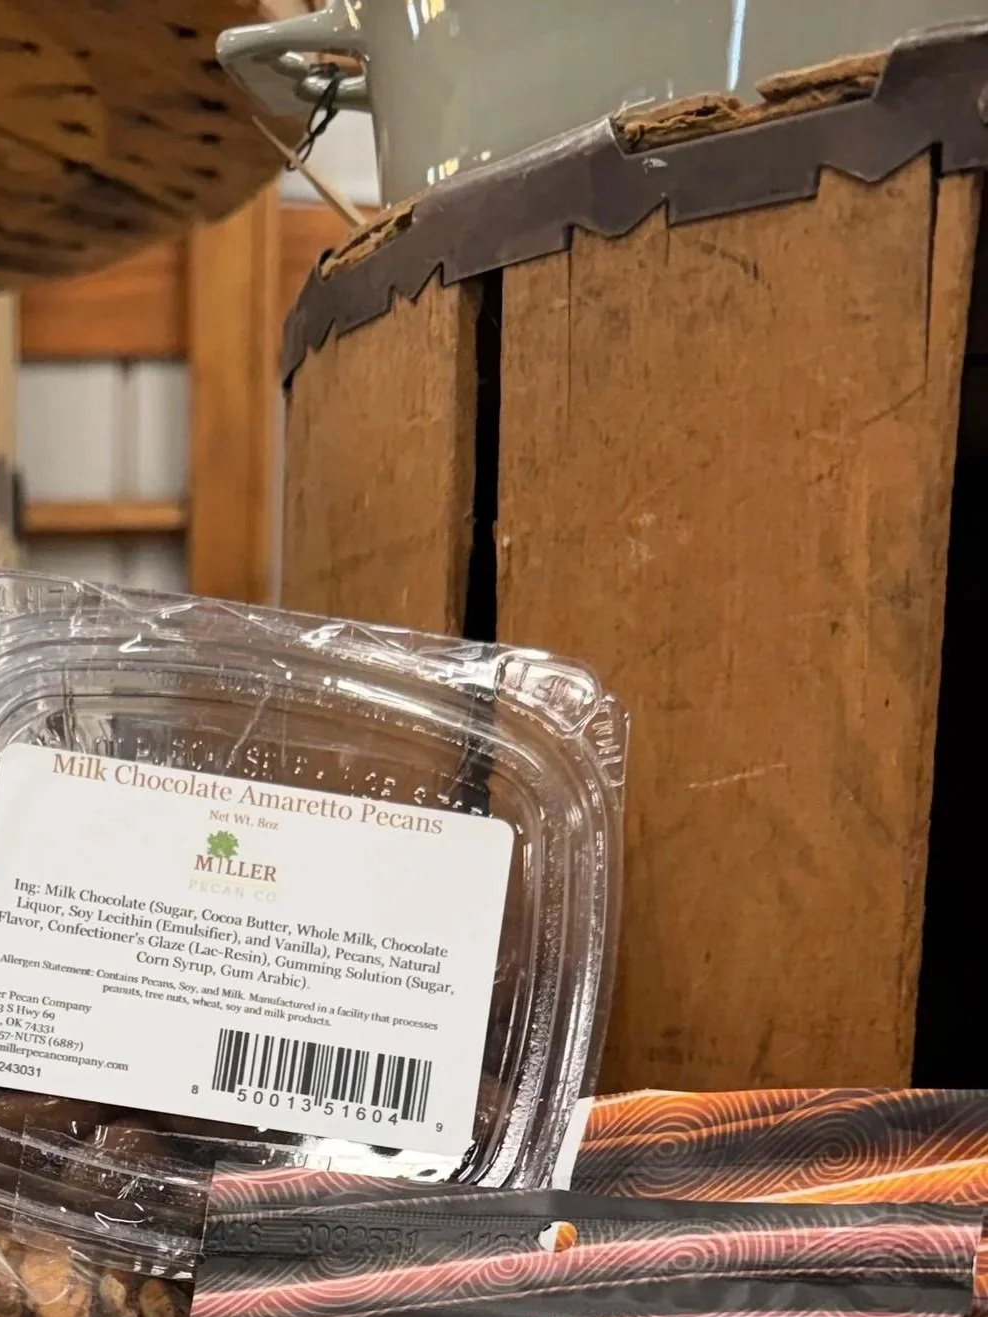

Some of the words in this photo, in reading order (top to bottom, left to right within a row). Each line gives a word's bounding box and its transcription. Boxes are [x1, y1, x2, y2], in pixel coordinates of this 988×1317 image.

[52, 753, 106, 781] Milk
[114, 764, 232, 801] Chocolate
[239, 785, 352, 820] Amaretto
[360, 803, 442, 834] Pecans
[209, 809, 230, 822] Net
[233, 813, 253, 826] Wt.
[257, 817, 278, 830] 8oz
[195, 854, 277, 883] MILLER
[14, 878, 40, 895] Ing:
[45, 883, 75, 899] Milk
[79, 889, 146, 910] Chocolate
[149, 900, 197, 920] (Sugar,
[201, 909, 242, 926] Cocoa
[246, 915, 291, 936] Butter,
[297, 923, 339, 941] Whole
[343, 931, 376, 949] Milk,
[381, 937, 448, 957] Chocolate
[17, 896, 64, 917] Liquor,
[68, 905, 94, 922] Soy
[97, 909, 152, 929] Lecithin
[155, 918, 241, 945] (Emulsifier),
[244, 935, 271, 947] and
[275, 937, 330, 959] Vanilla),
[335, 947, 384, 968] Pecans,
[389, 955, 440, 974] Natural
[47, 919, 144, 945] Confectioner's
[148, 935, 185, 951] Glaze
[188, 941, 270, 967] (Lac-Resin),
[274, 955, 342, 979] Gumming
[345, 966, 402, 986] Solution
[405, 975, 453, 995] (Sugar,
[136, 951, 169, 967] Corn
[172, 956, 216, 976] Syrup,
[220, 964, 253, 980] Gum
[256, 970, 309, 990] Arabic).
